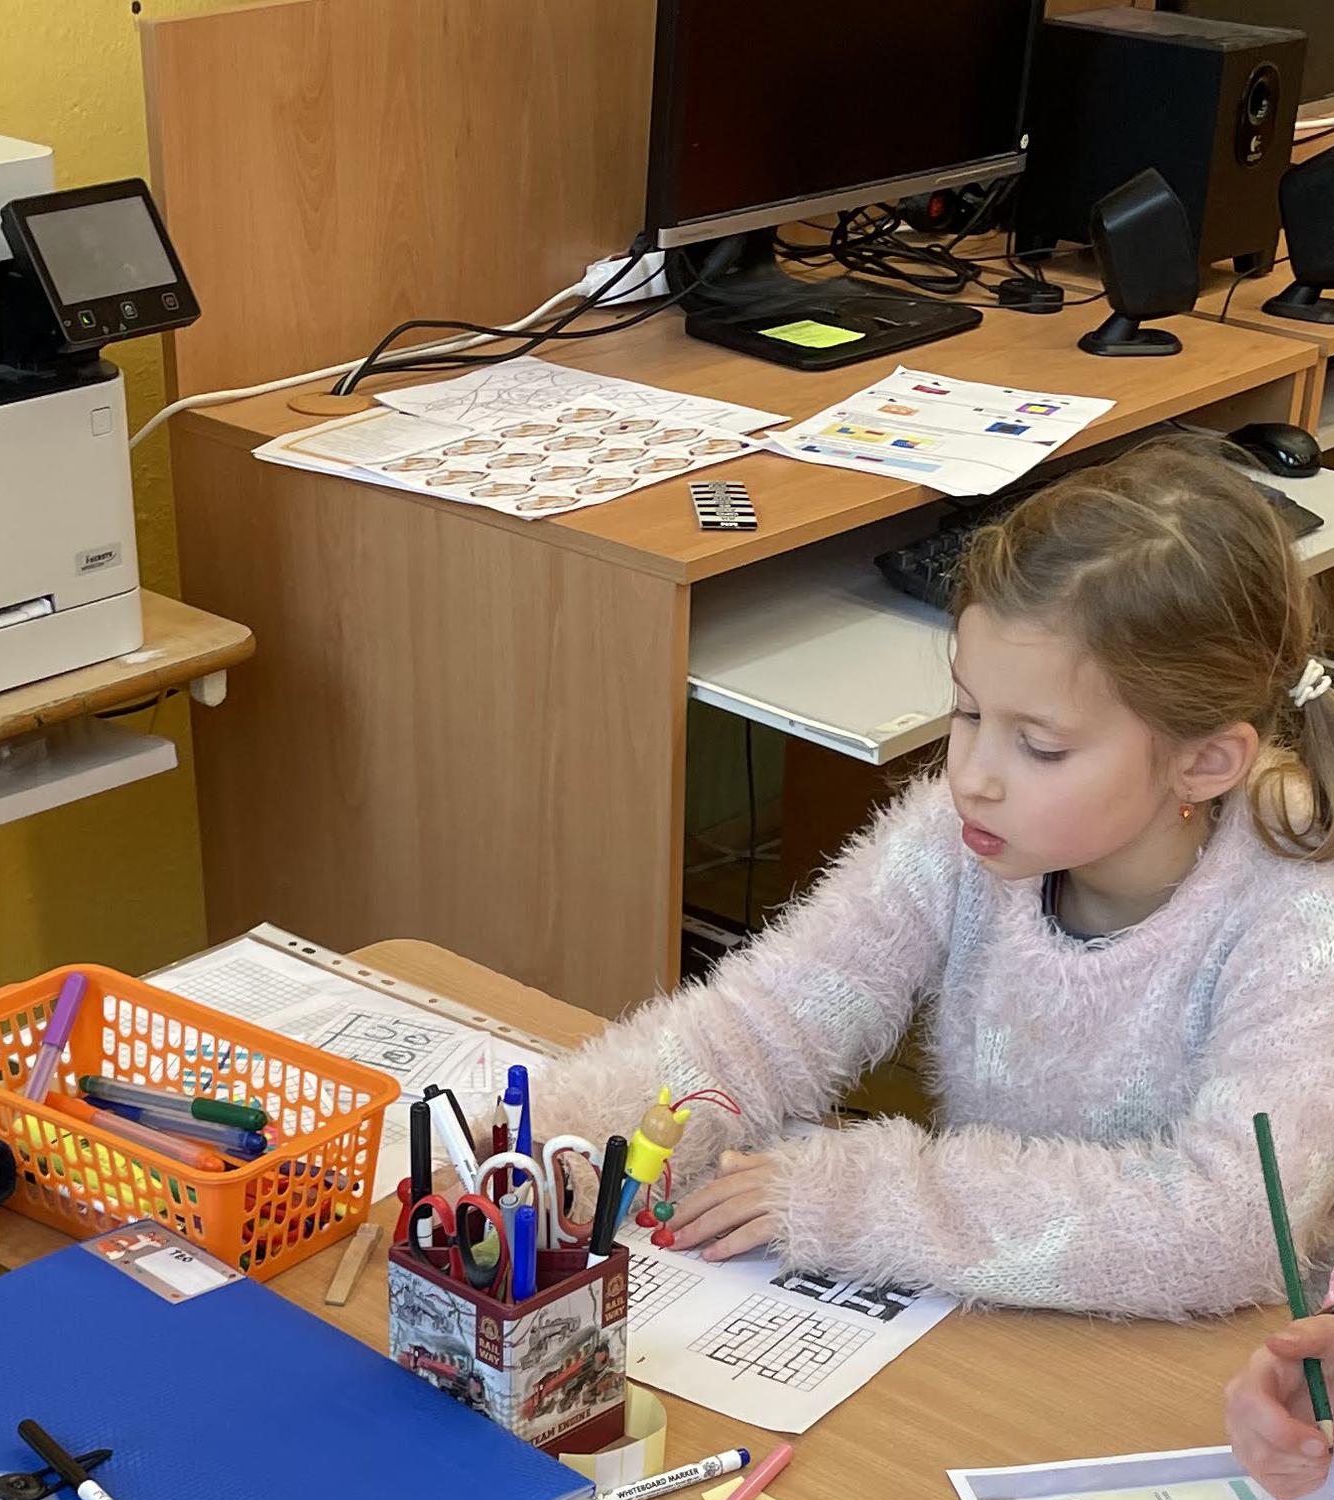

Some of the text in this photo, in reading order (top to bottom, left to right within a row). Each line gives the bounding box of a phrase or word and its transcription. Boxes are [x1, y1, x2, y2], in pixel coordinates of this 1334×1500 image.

[168, 1249, 194, 1264] TEO
[605, 1295, 626, 1311] RAIL
[604, 1305, 625, 1322] WAY
[478, 1336, 501, 1355] RAIL
[478, 1349, 501, 1366] WAY
[557, 1407, 591, 1433] ENGINE
[617, 1467, 700, 1499] WHITEBOARD MARKER
